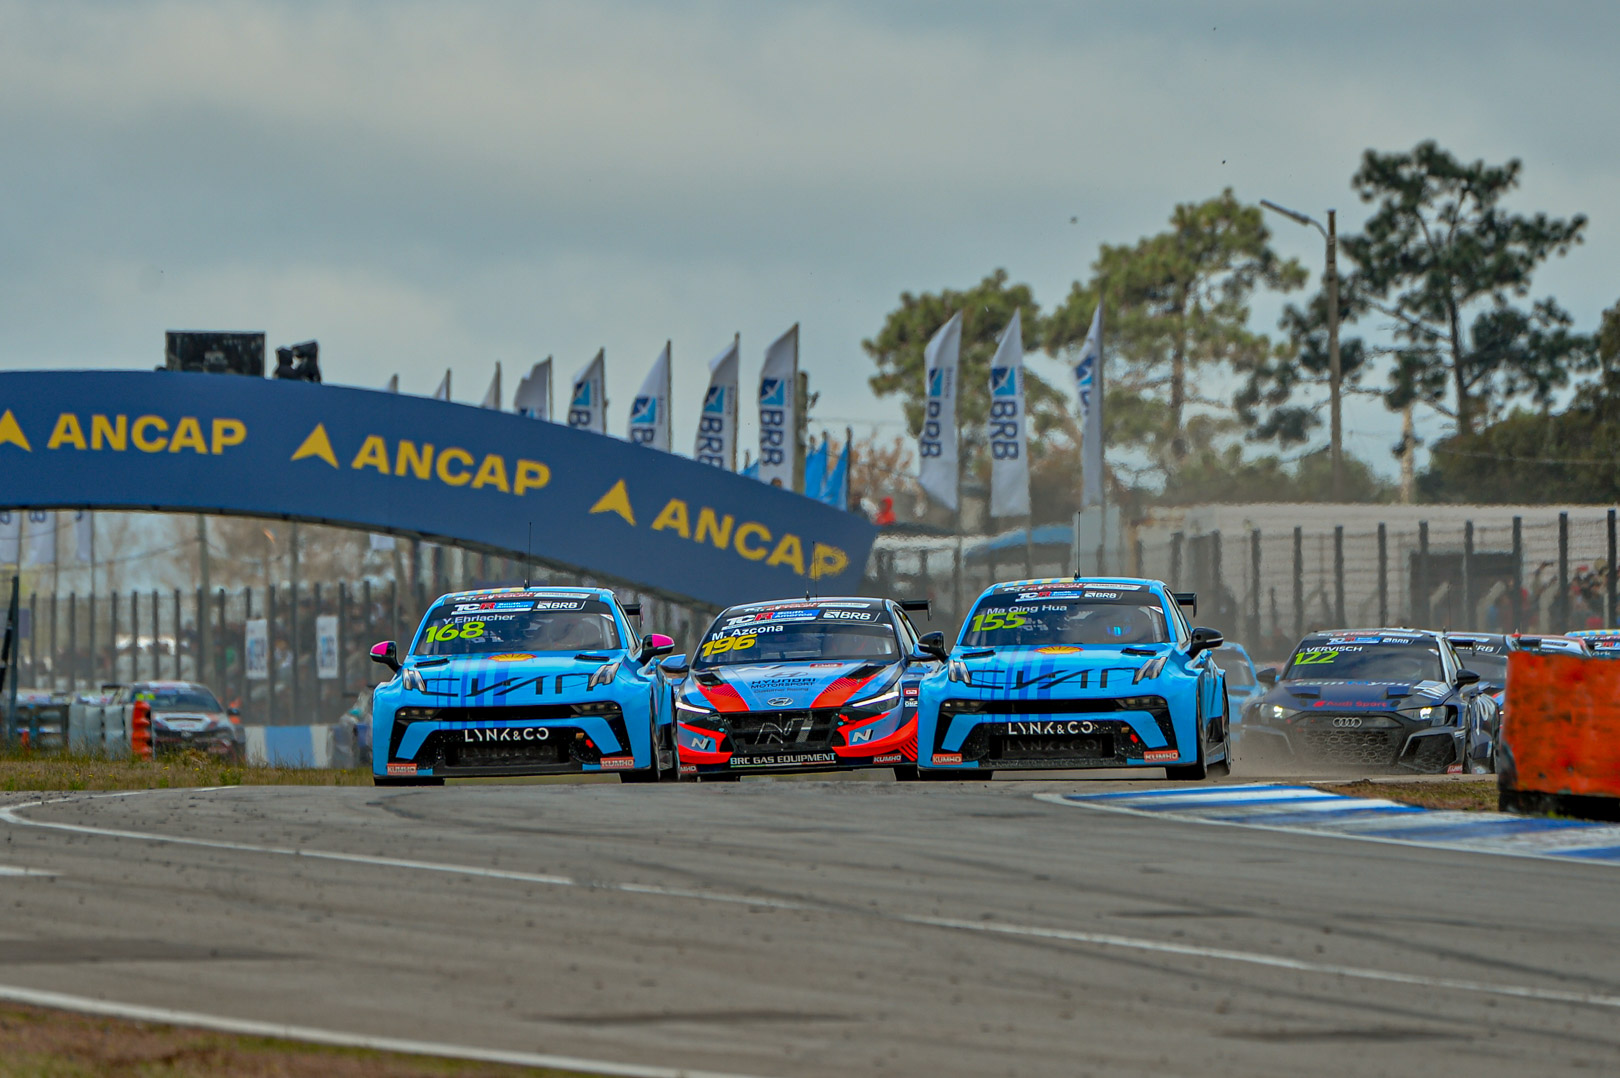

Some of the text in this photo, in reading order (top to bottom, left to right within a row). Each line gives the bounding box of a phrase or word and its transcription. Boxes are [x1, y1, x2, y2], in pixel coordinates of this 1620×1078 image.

[47, 412, 247, 455] ANCAP
[990, 400, 1019, 460] BRB
[760, 409, 784, 466] BRB
[350, 434, 551, 496] ANCAP
[650, 498, 850, 579] ANCAP
[454, 602, 496, 612] TCR
[1008, 605, 1038, 614] Qing
[1041, 604, 1068, 612] Hua
[726, 612, 774, 626] TCR
[840, 611, 872, 620] BRB
[972, 611, 1028, 632] 155
[426, 621, 486, 643] 168
[711, 624, 784, 641] M. Azcona
[702, 634, 757, 657] 196
[1294, 651, 1339, 665] 122
[464, 727, 550, 742] LYNK&CO
[1008, 721, 1093, 735] LYNK&CO
[601, 759, 634, 767] KUMHO
[730, 752, 836, 765] BRC GAS EQUIPMENT
[873, 754, 902, 763] KUMHO
[1145, 752, 1178, 760] KUMHO
[387, 765, 417, 774] KUMHO
